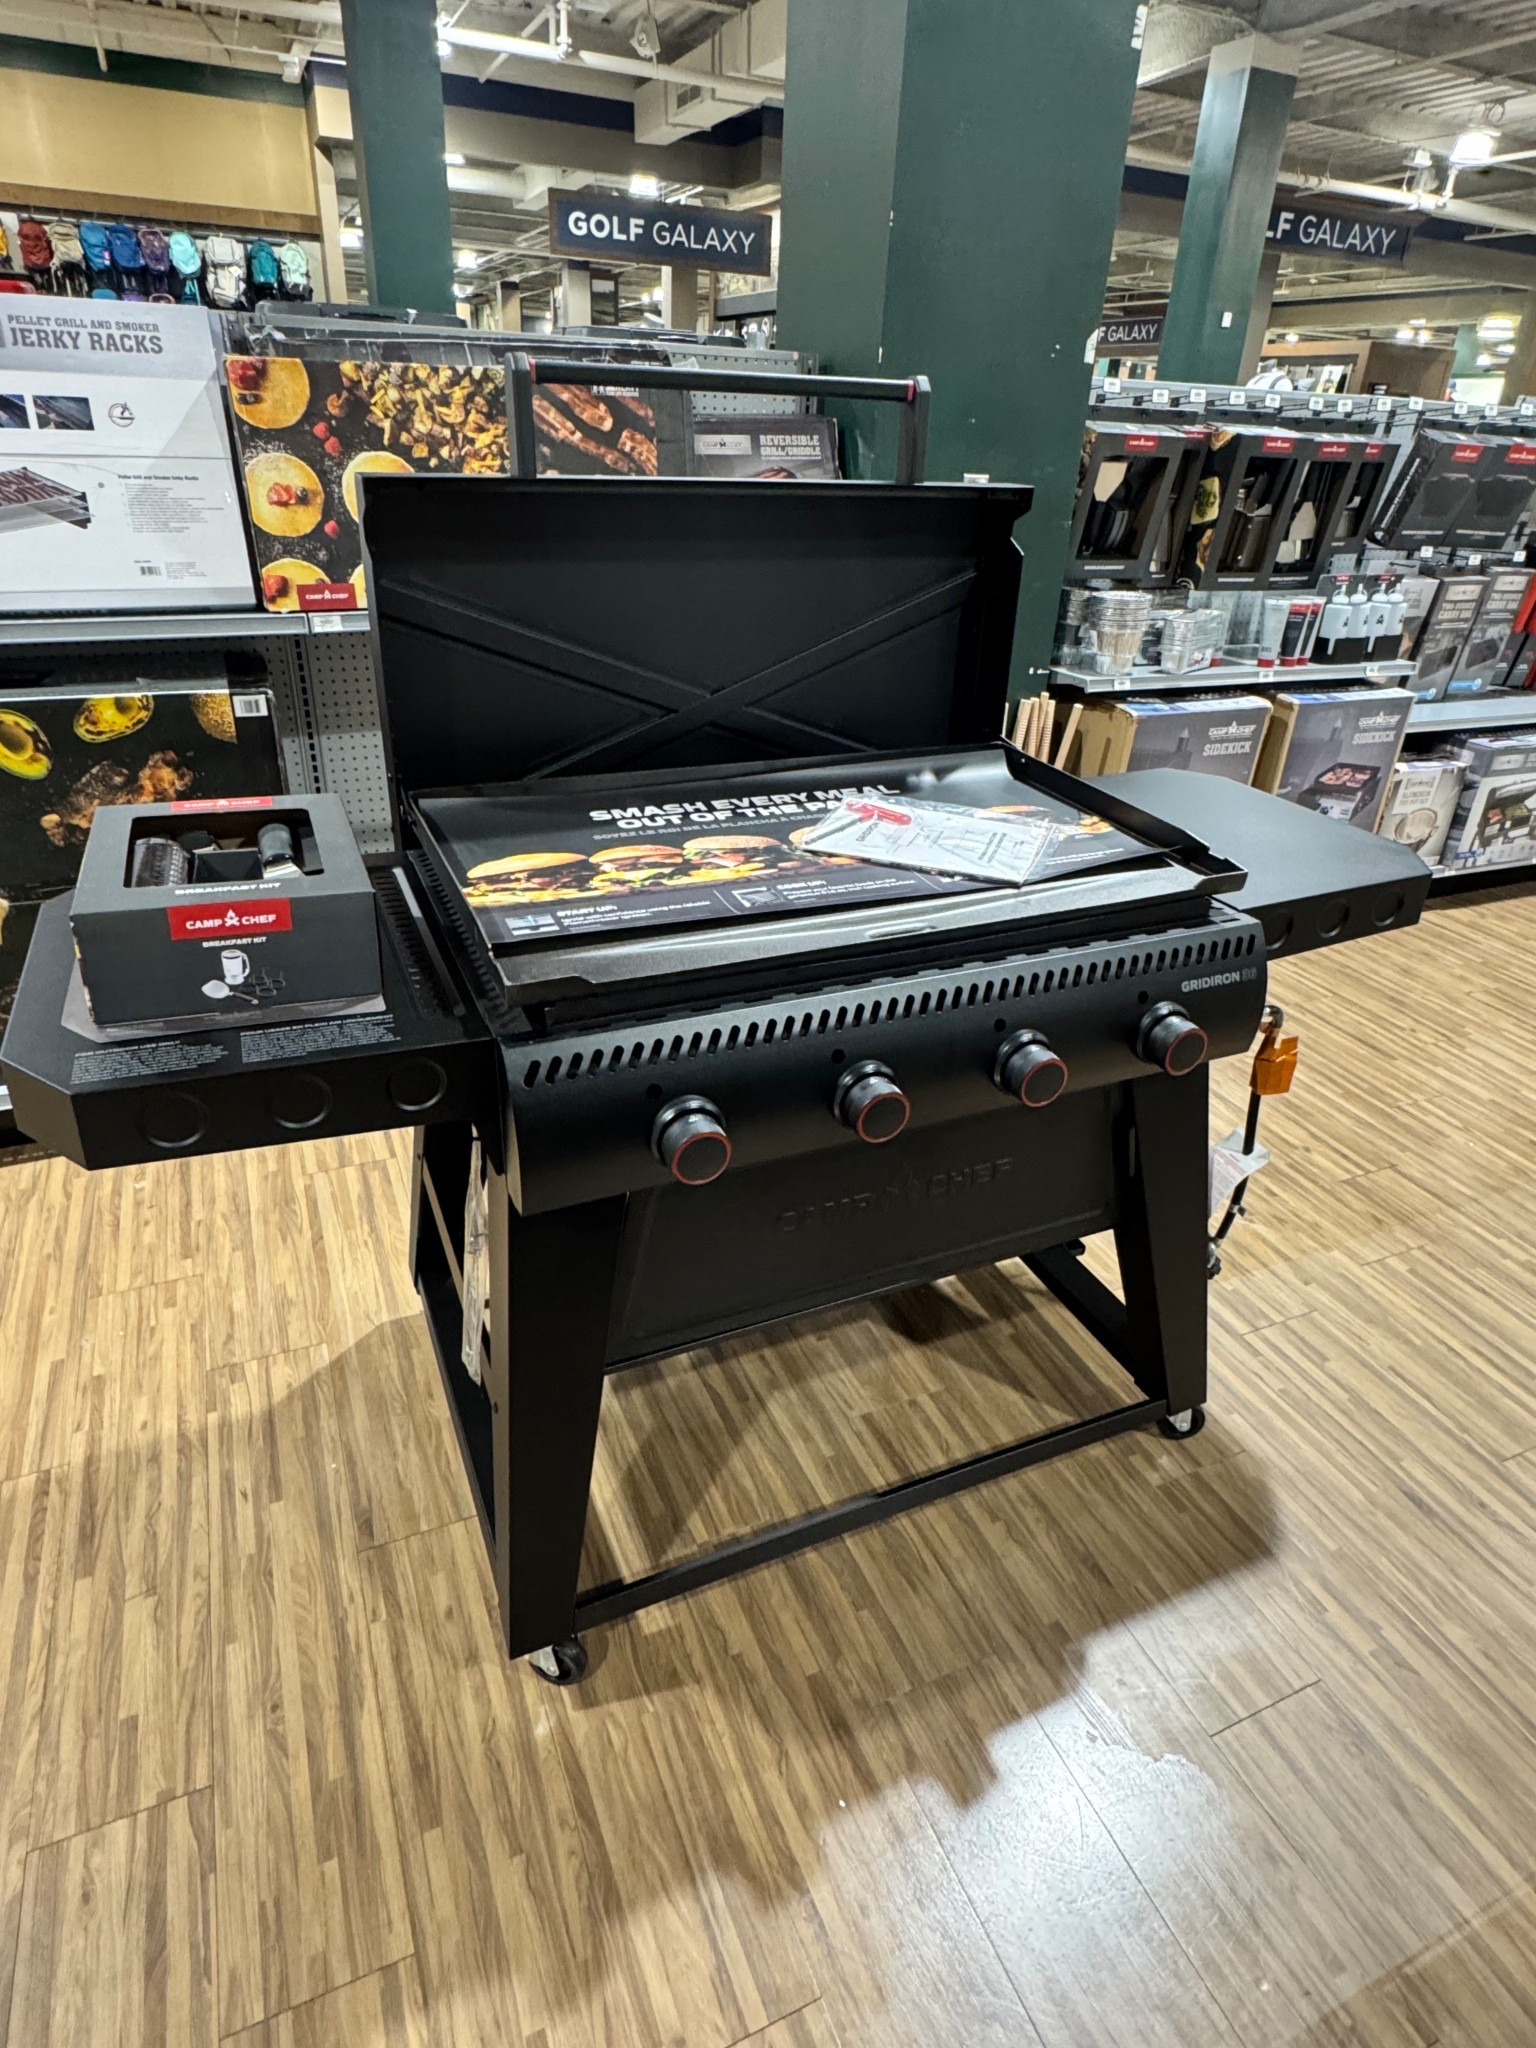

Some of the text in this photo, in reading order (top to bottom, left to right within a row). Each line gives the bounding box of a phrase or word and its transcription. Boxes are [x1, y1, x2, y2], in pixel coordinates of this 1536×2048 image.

[568, 211, 756, 255] GOLF GALAXY
[1299, 215, 1397, 255] GALAXY
[7, 314, 160, 333] PELLET GRILL AND SMOKER
[10, 327, 163, 354] JERKY RACKS
[1108, 324, 1158, 342] GALAXY
[759, 435, 820, 446] REVERSIBLE
[1352, 730, 1397, 745] SIDEKICK
[1202, 741, 1252, 756] SIDEKICK
[589, 784, 901, 822] SMASH EVERY MEAL
[616, 813, 683, 830] OUT
[689, 809, 734, 823] OF
[737, 802, 803, 818] THE
[721, 818, 777, 827] PLANCHA
[174, 883, 258, 895] BREAKFAST
[186, 914, 277, 930] CAMP CHEF
[202, 936, 267, 948] BREAKFAST KIT
[1181, 971, 1240, 993] GRIDIRON
